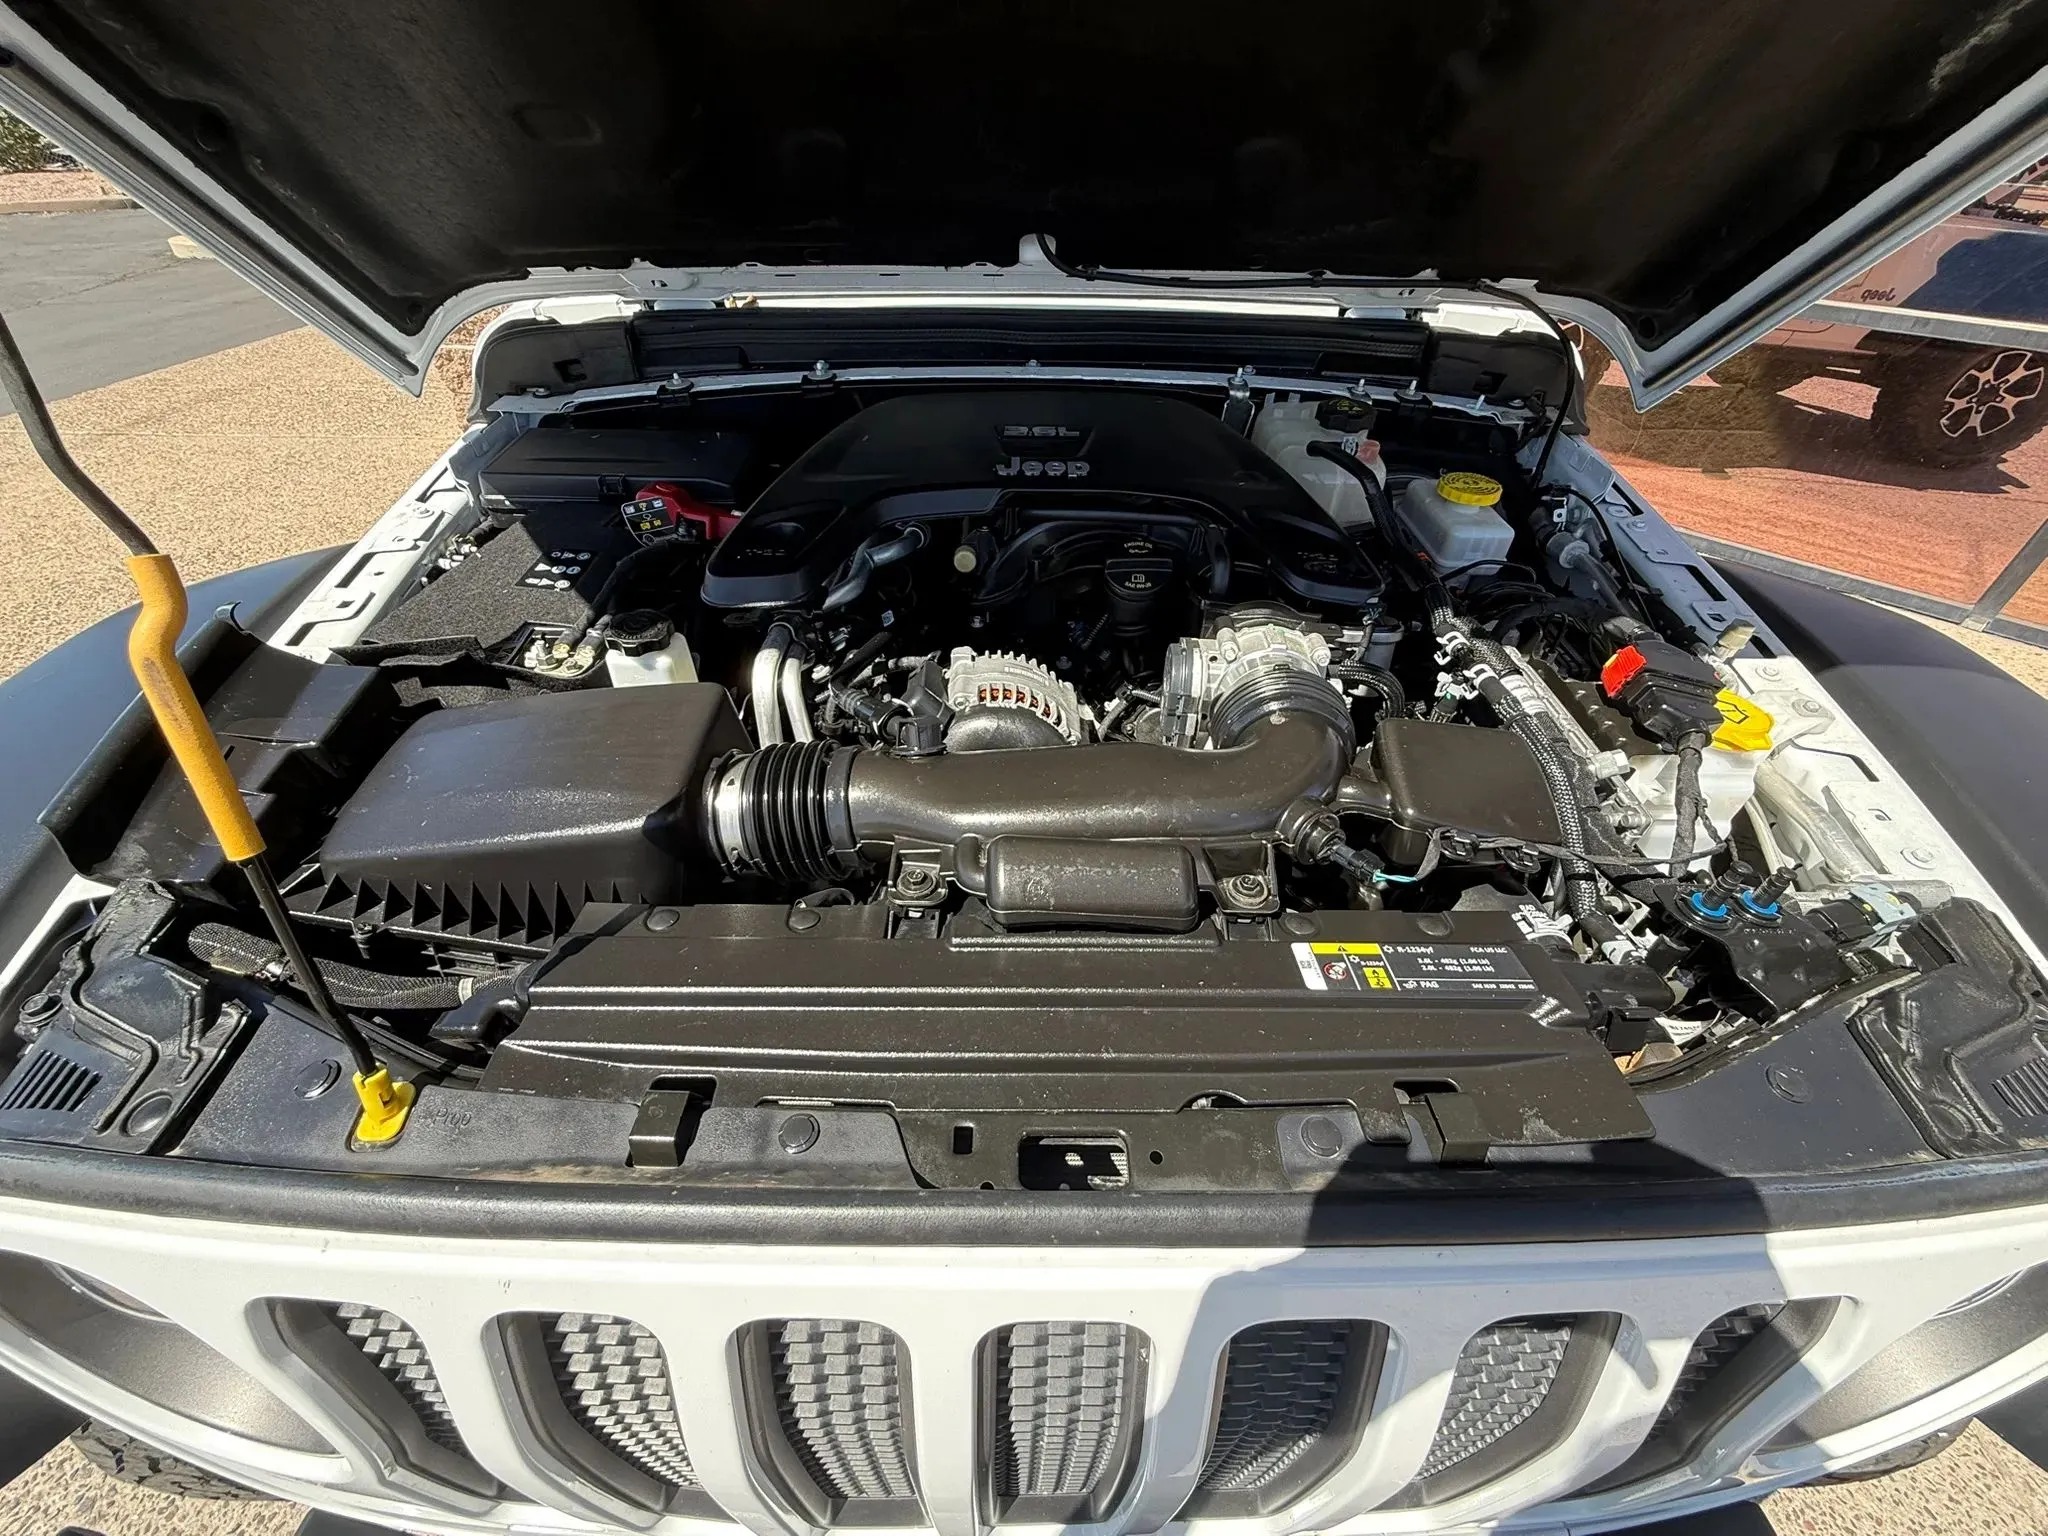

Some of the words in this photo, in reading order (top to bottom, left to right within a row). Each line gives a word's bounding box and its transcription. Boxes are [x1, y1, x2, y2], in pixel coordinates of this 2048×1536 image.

[995, 456, 1090, 477] Jeep
[1123, 541, 1144, 549] ENGINE
[1396, 946, 1434, 955] R-1234yf
[1419, 980, 1440, 988] PAG
